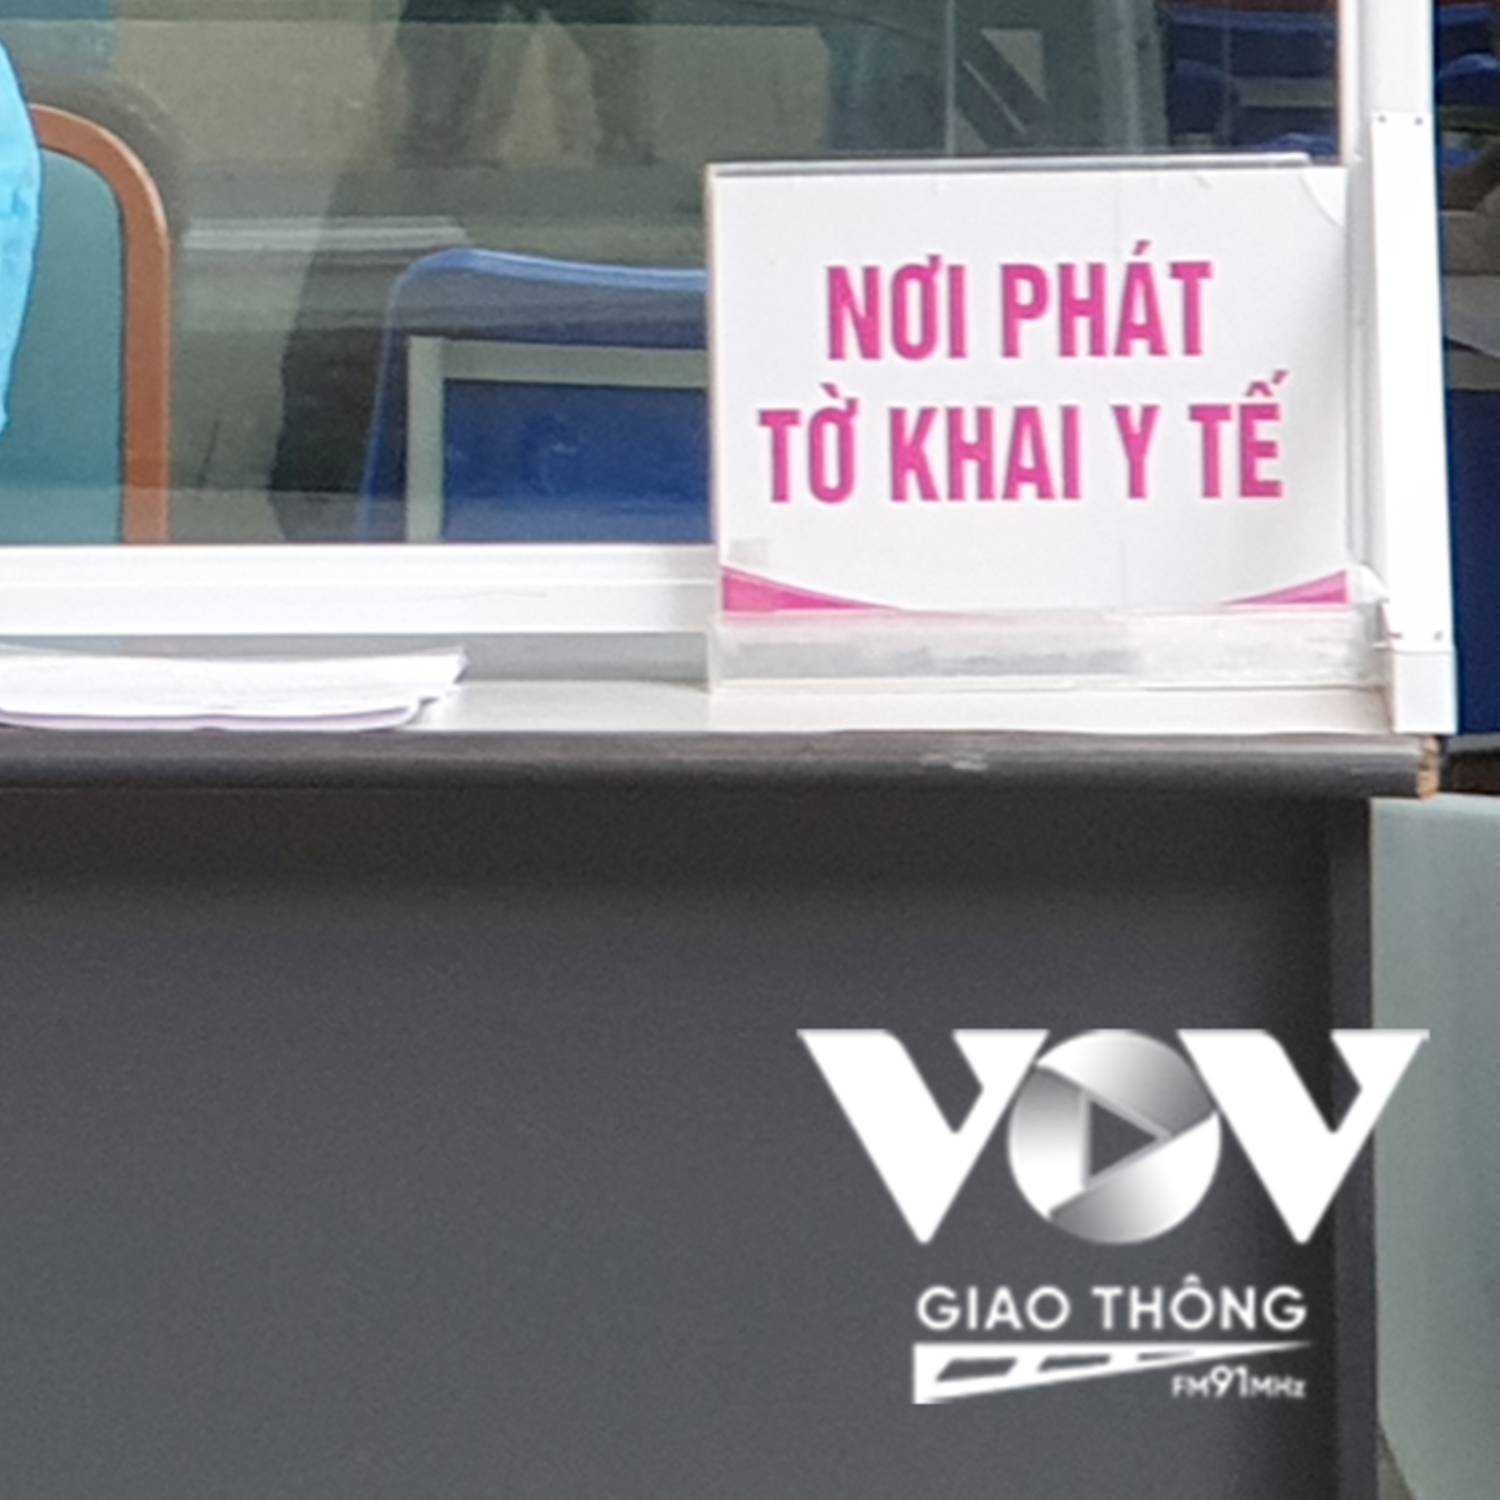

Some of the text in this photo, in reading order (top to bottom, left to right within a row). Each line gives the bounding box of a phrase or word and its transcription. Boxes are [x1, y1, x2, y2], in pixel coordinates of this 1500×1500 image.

[825, 239, 1213, 361] NƠI PHÁT
[757, 369, 1290, 503] TỜ KHAI Y TẾ
